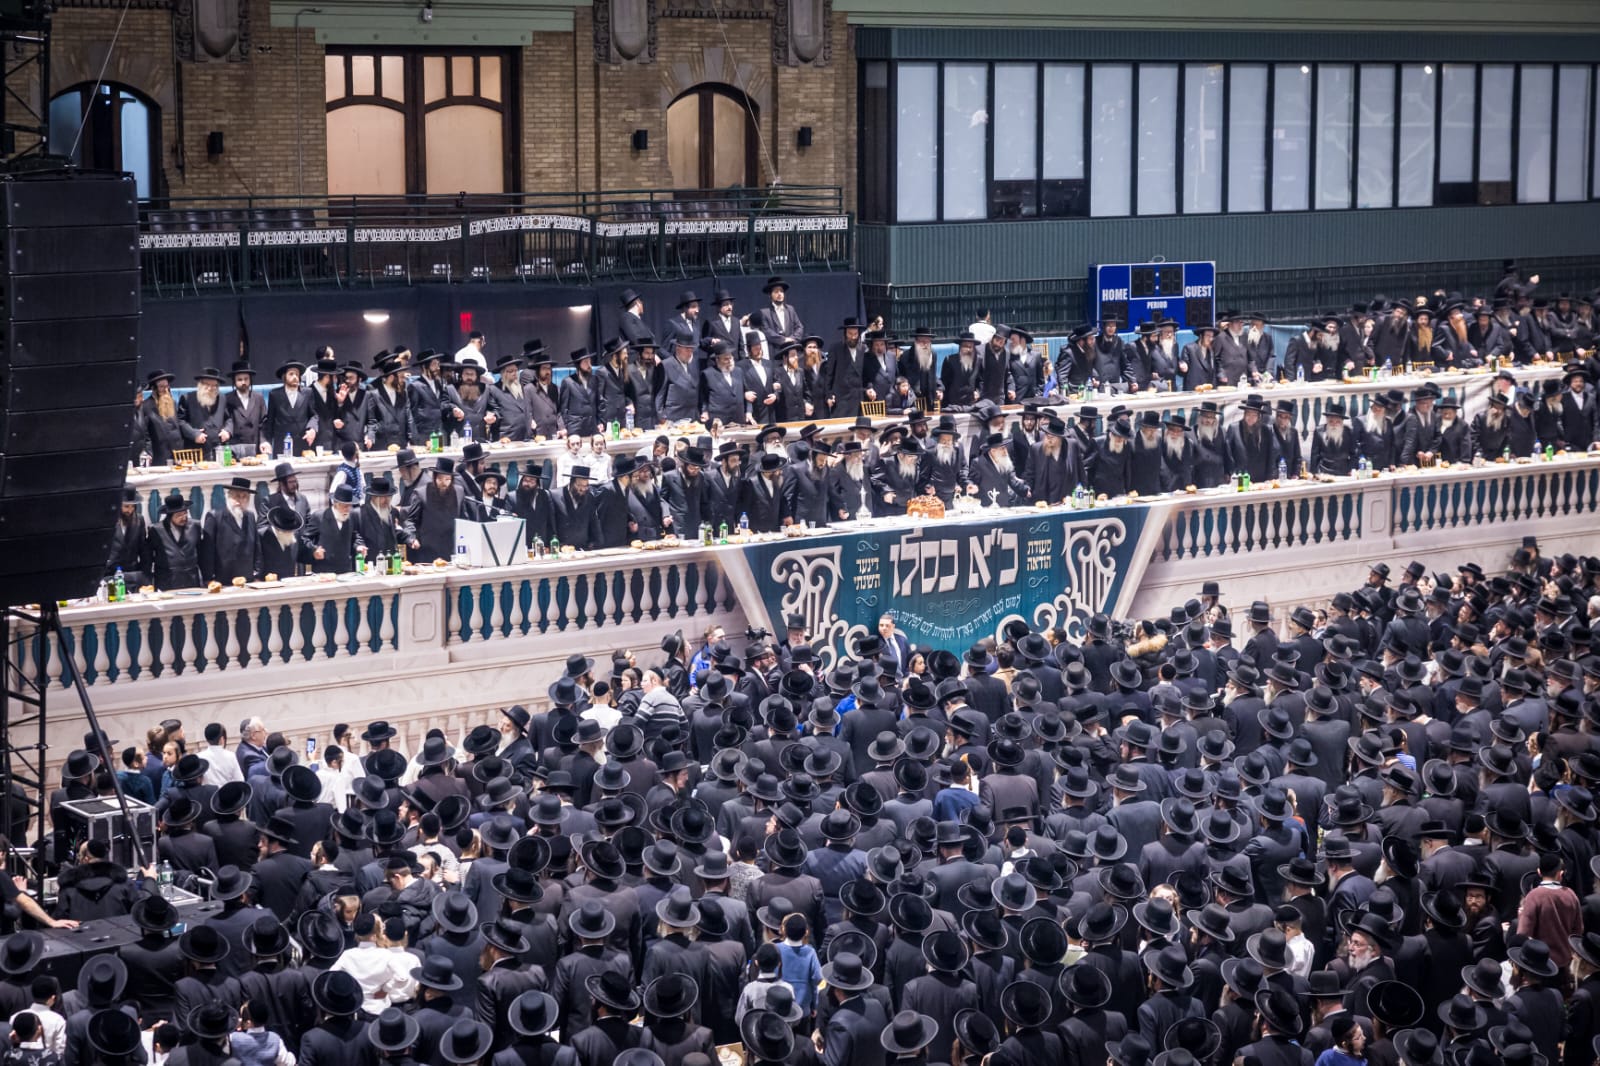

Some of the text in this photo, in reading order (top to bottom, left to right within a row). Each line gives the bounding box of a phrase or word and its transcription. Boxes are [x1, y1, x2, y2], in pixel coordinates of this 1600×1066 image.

[1102, 288, 1128, 301] HOME
[1185, 285, 1213, 298] GUEST
[1146, 301, 1168, 309] PERIOD
[1027, 539, 1052, 555] סעודת
[856, 557, 879, 575] דינער
[889, 527, 958, 599] כסלו
[1027, 555, 1051, 571] הודאה
[853, 574, 880, 591] השנתי
